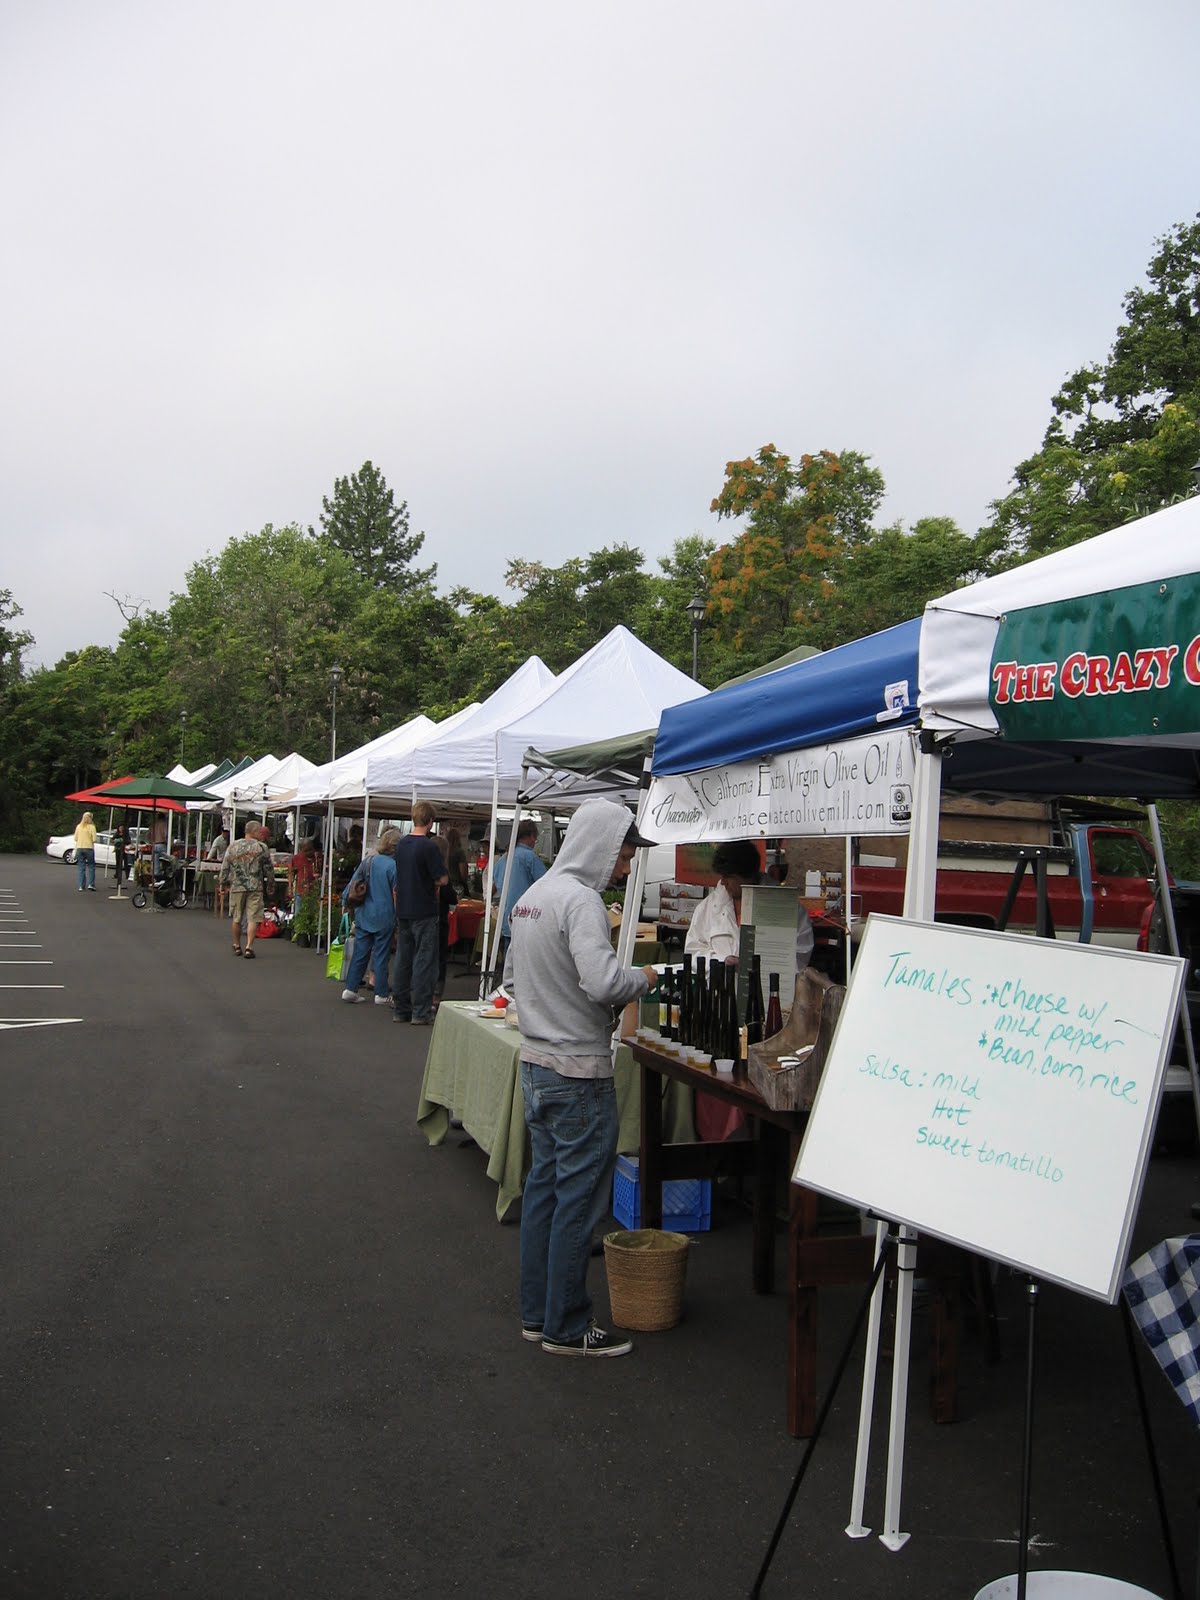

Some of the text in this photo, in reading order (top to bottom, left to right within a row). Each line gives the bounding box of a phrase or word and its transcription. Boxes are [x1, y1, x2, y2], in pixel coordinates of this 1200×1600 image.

[993, 661, 1057, 705] THE
[1060, 645, 1179, 699] CRAZY
[758, 764, 785, 796] Extra
[788, 759, 818, 797] Virgin
[824, 751, 857, 789] Olive
[864, 742, 889, 784] Oil
[1078, 1002, 1108, 1027] w/
[1045, 1024, 1124, 1054] pepper
[931, 1099, 971, 1126] Hot
[978, 1141, 1064, 1182] tomatillo
